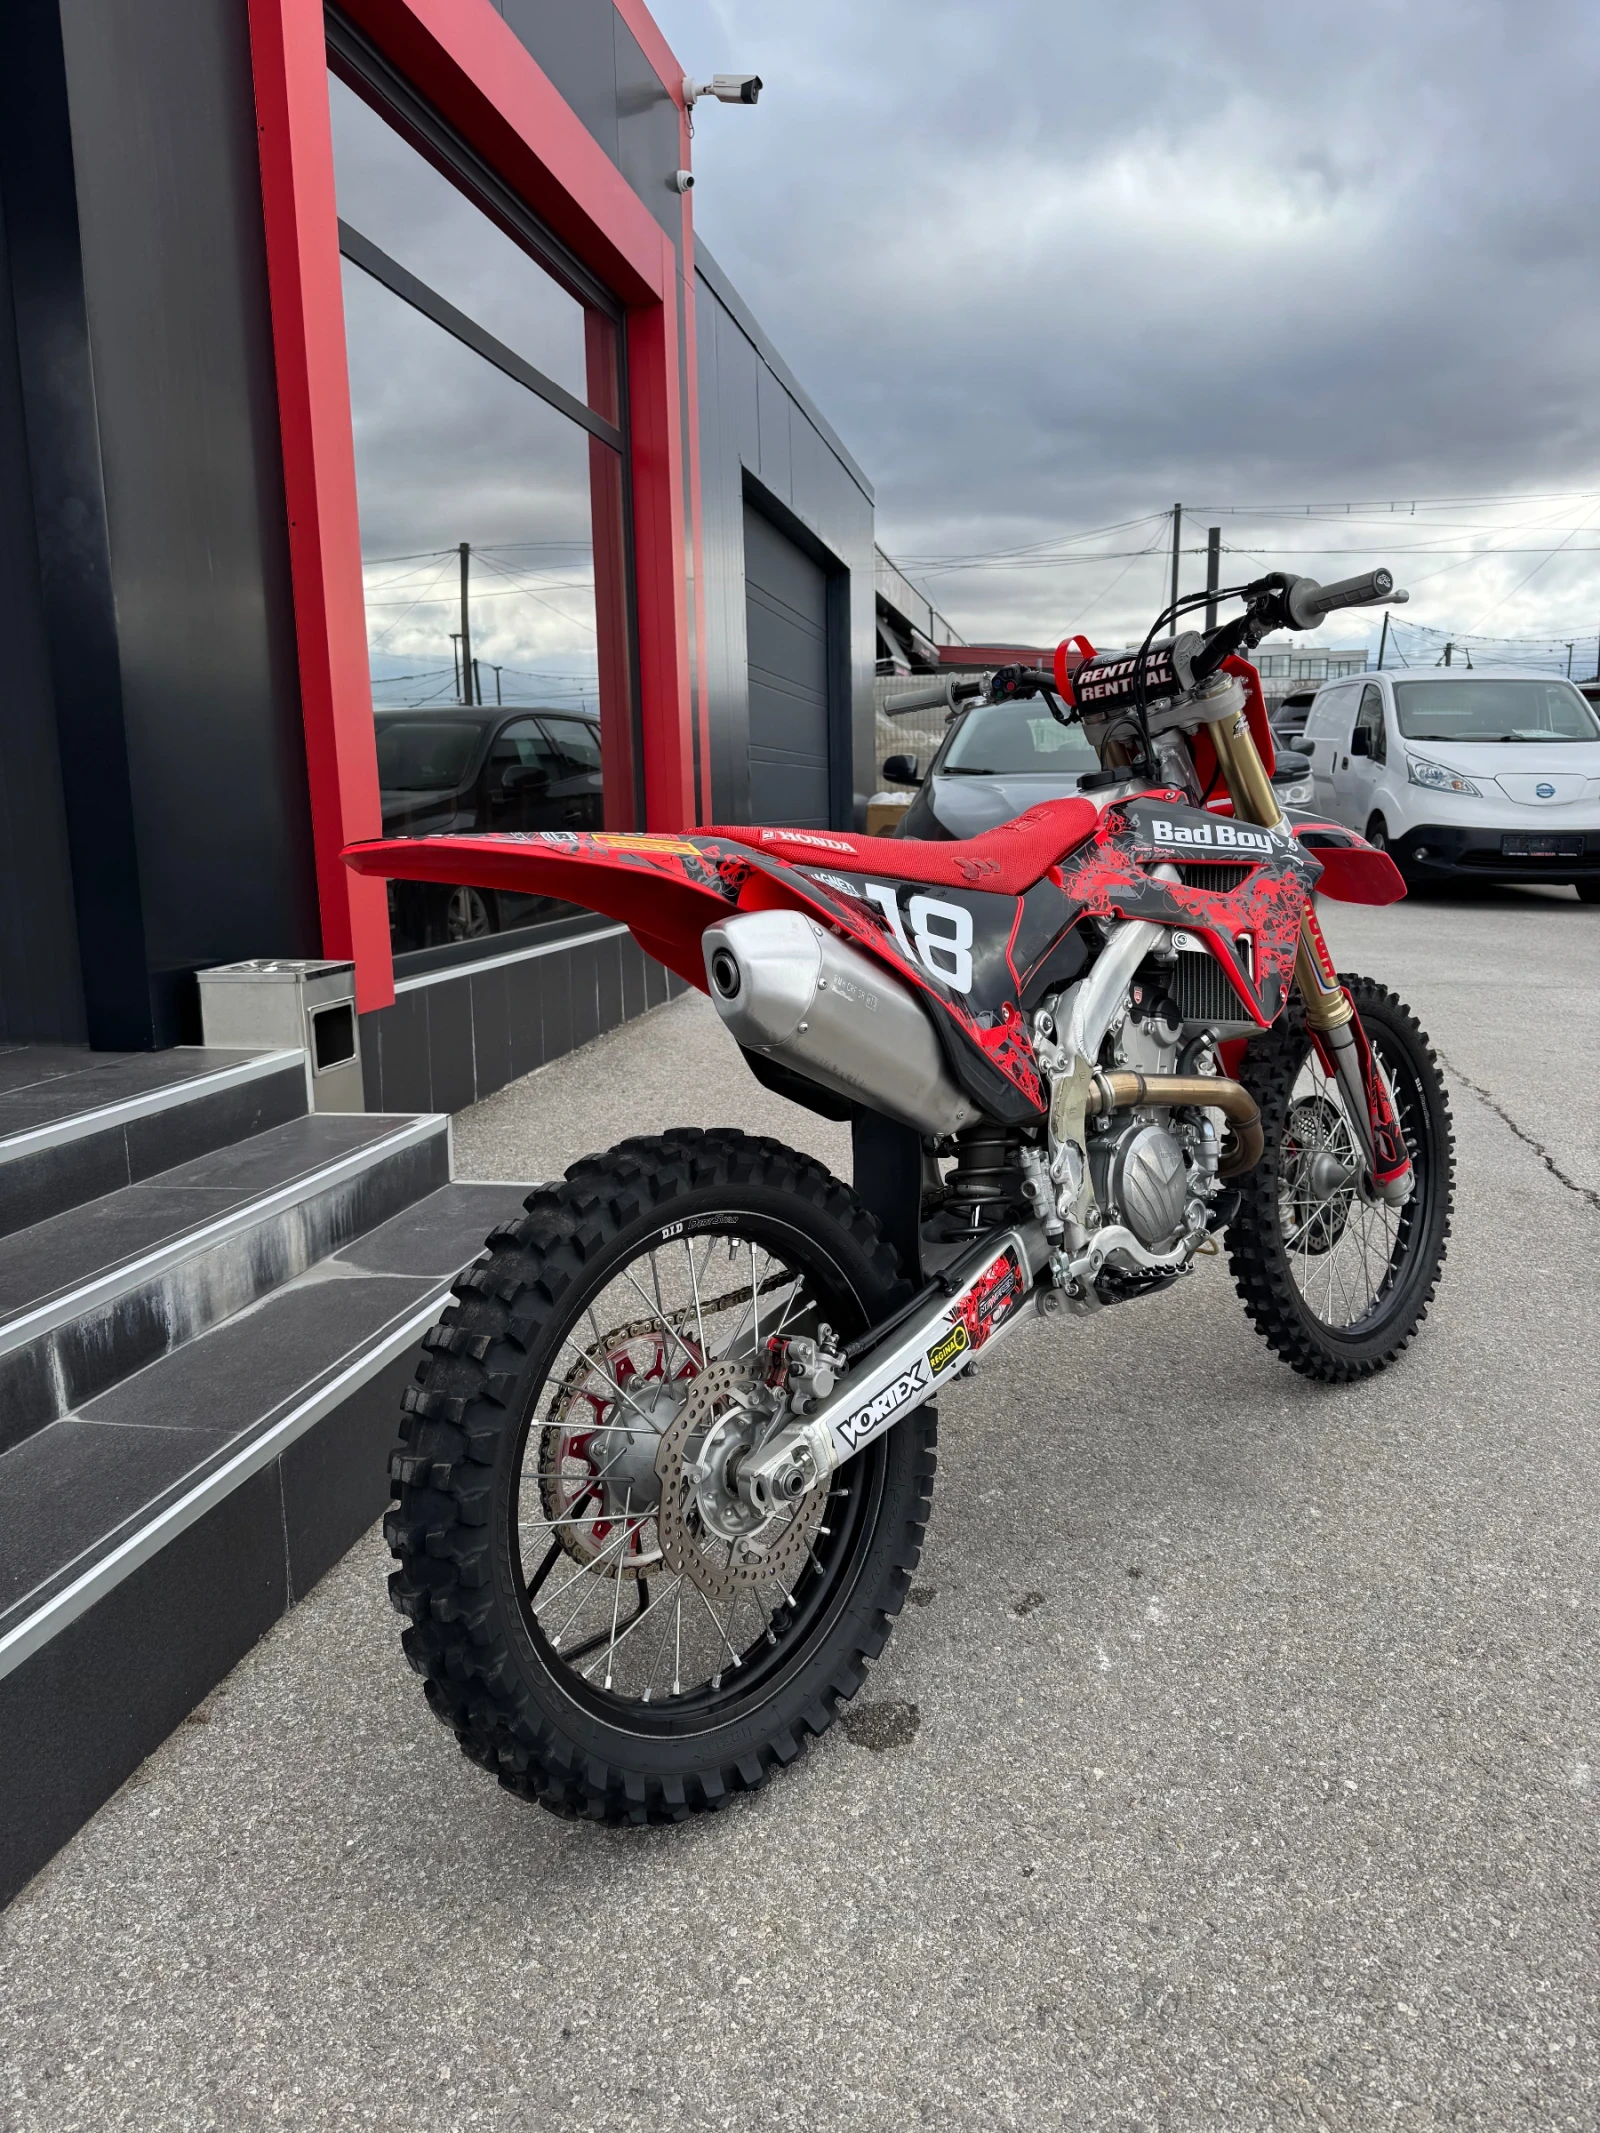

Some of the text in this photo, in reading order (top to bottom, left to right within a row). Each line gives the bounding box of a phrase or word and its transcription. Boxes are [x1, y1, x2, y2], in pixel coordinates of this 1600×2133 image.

[776, 830, 858, 854] HONDA
[1152, 820, 1273, 854] Bad Boy
[864, 882, 974, 995] 18
[1304, 897, 1336, 979] HOWA
[929, 1342, 956, 1368] REGINA
[835, 1357, 929, 1451] VORTEX
